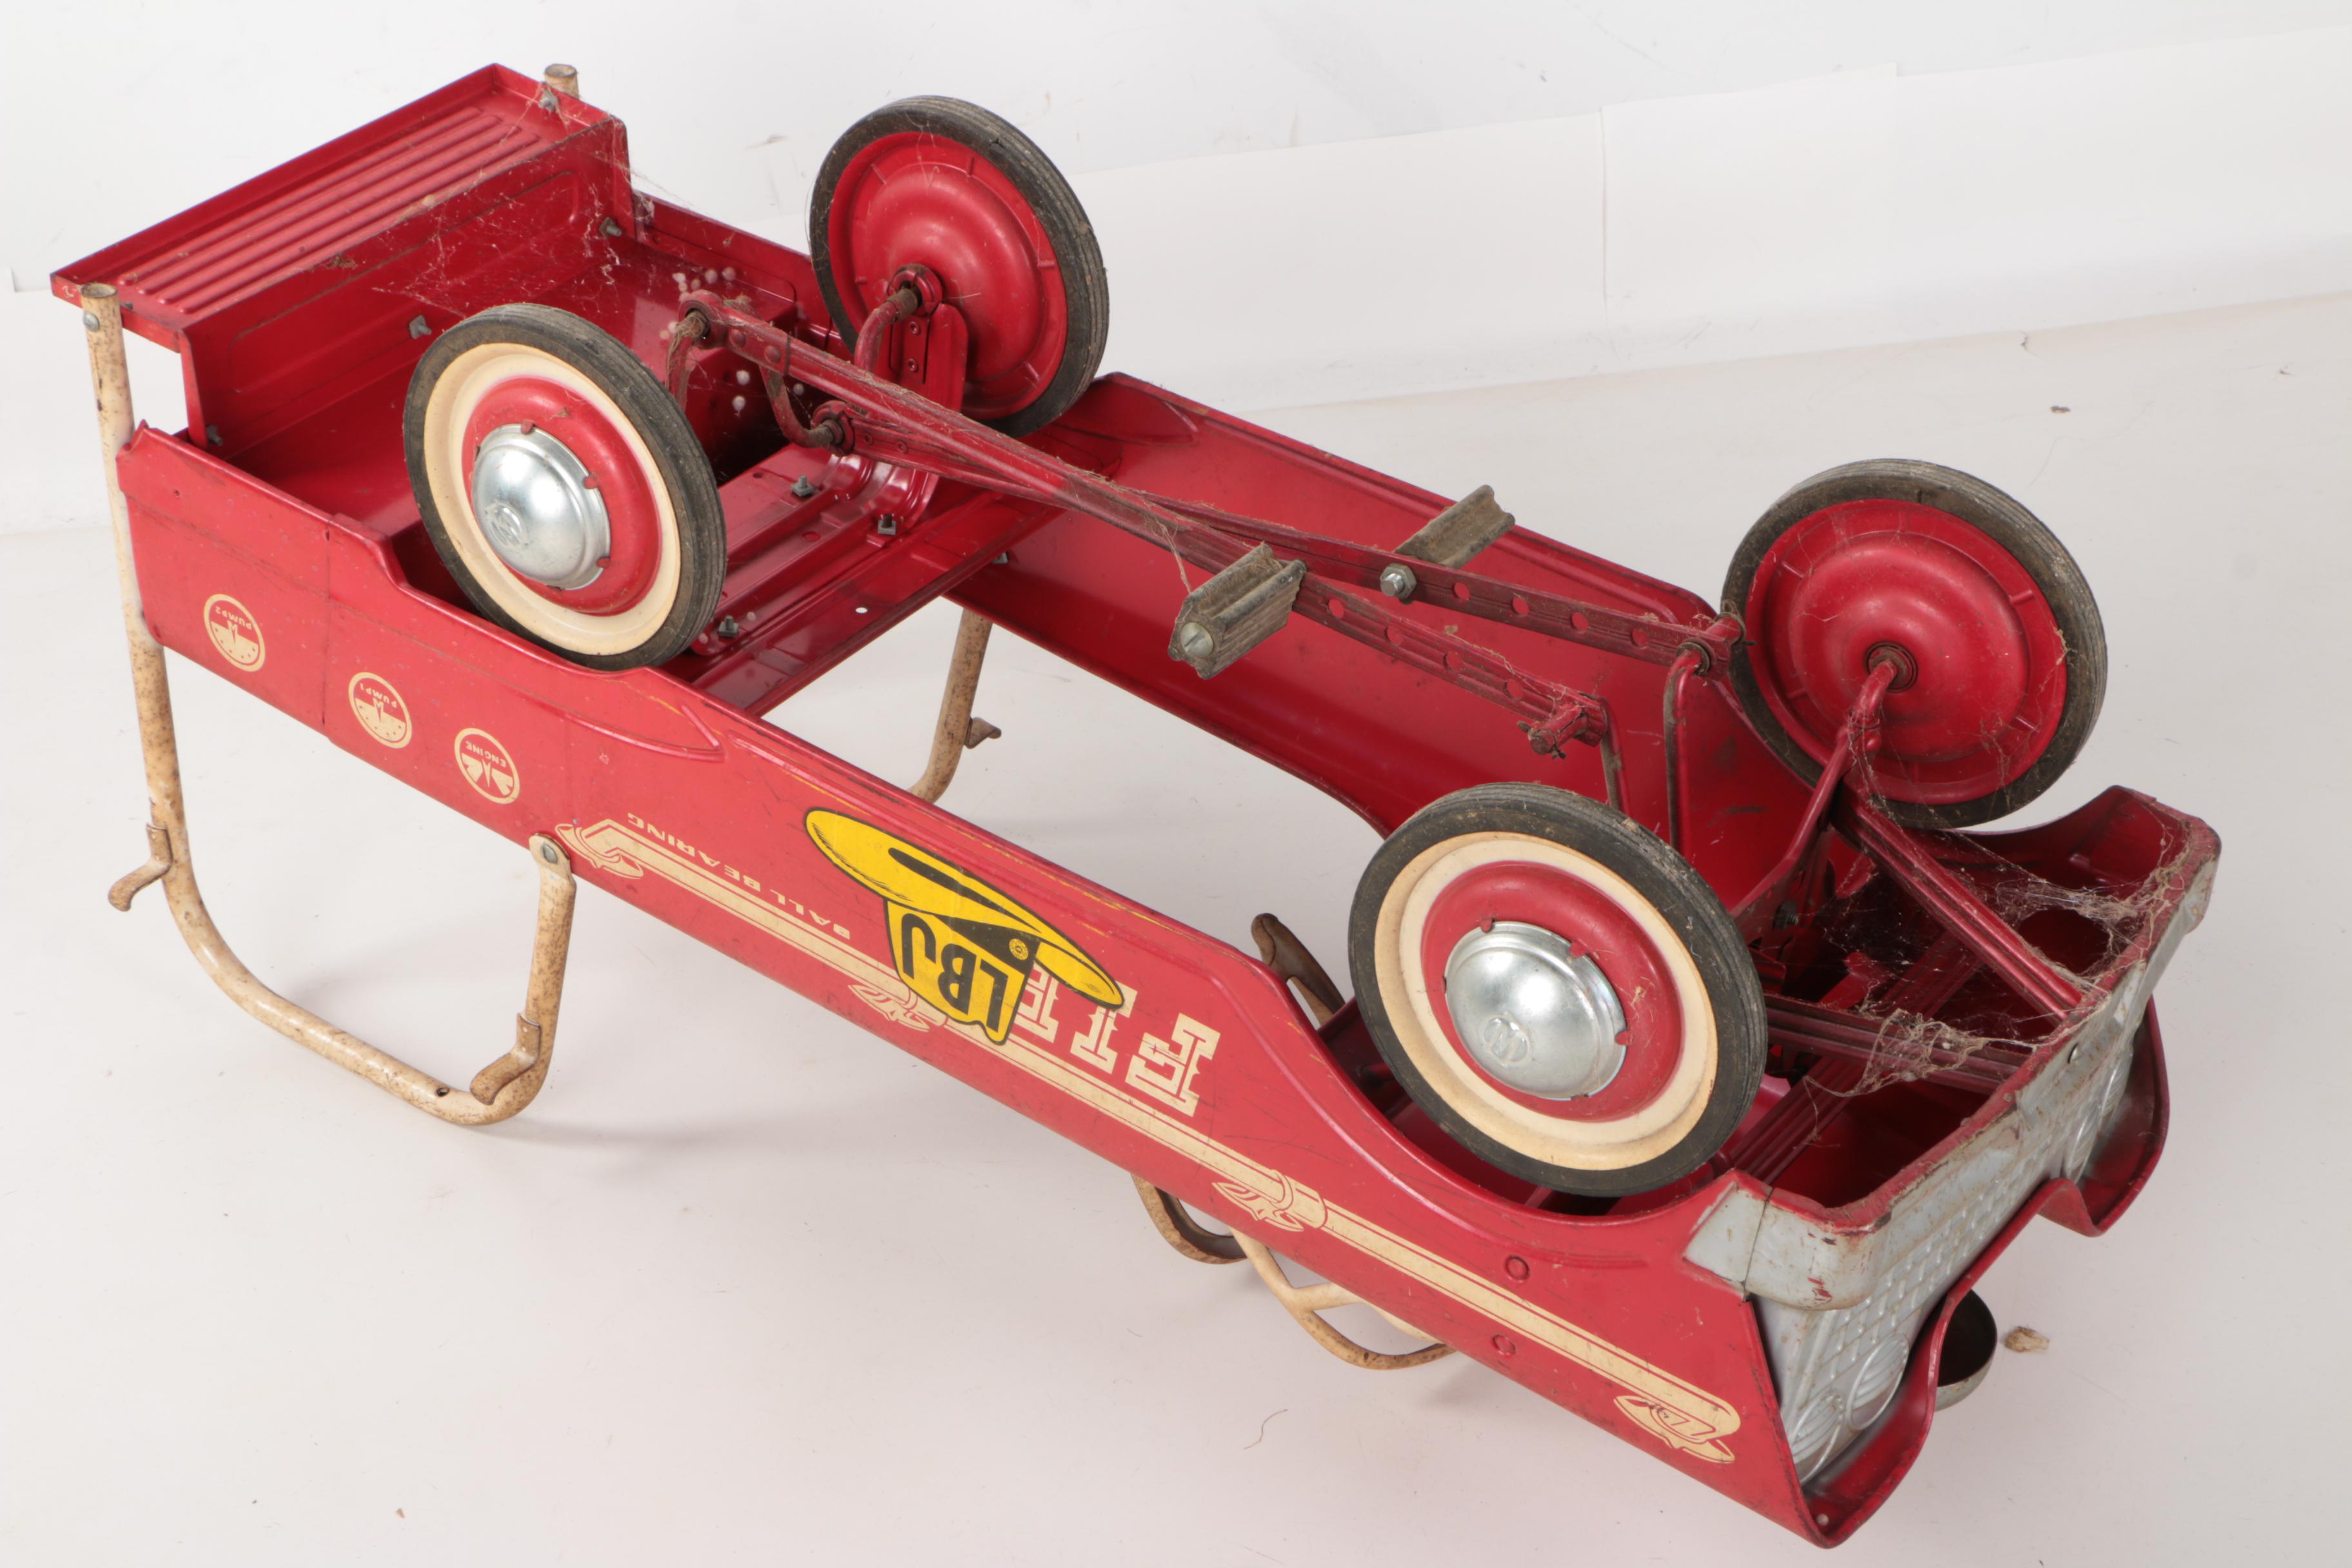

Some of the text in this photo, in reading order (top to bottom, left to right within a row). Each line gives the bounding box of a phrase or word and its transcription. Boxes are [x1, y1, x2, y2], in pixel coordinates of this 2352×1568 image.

[465, 740, 507, 768] ENGINE
[627, 812, 851, 940] BALL BEARING
[901, 912, 1009, 1033] LBJ
